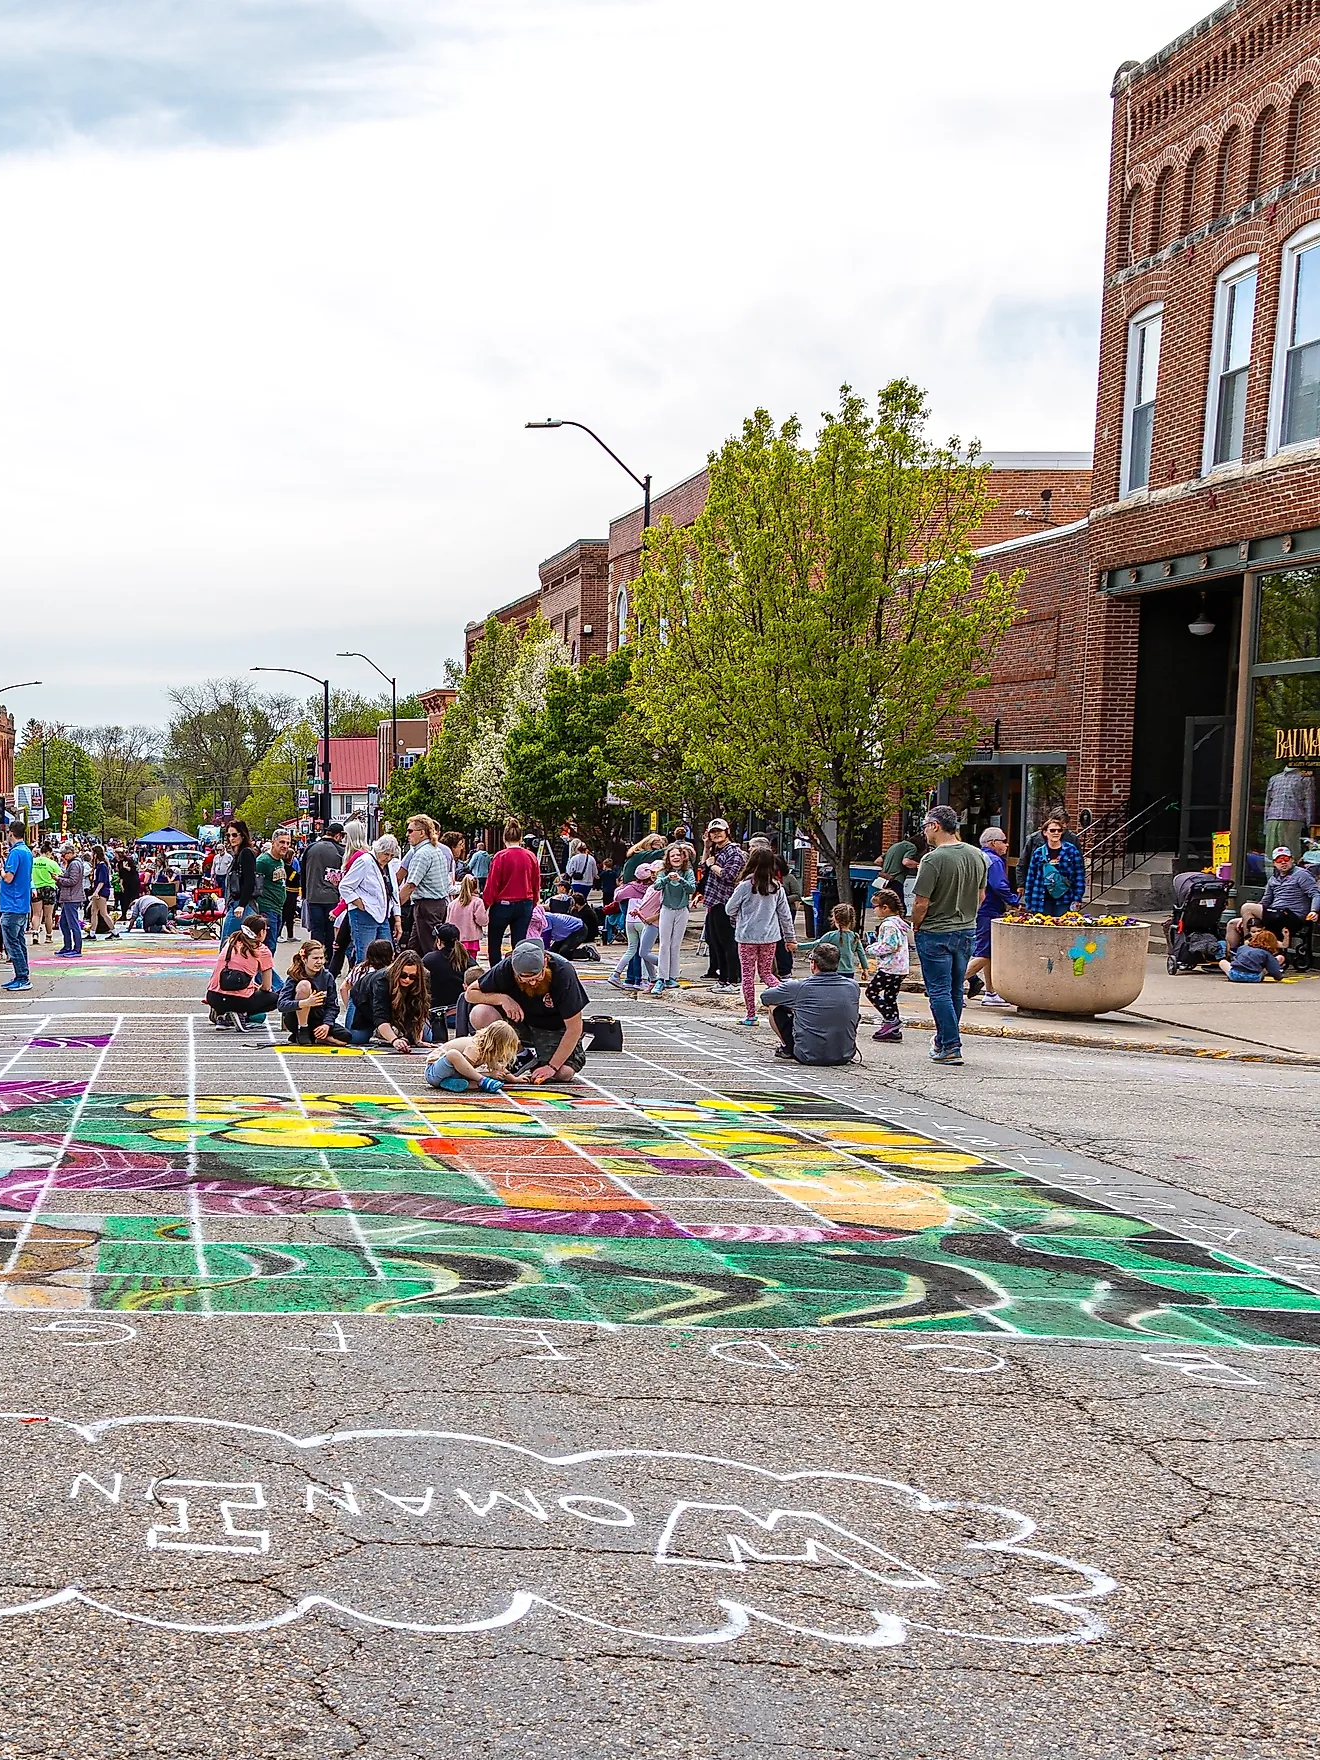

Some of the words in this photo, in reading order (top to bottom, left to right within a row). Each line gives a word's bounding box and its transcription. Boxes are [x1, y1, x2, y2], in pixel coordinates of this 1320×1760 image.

[1104, 1190, 1176, 1209] 5
[1179, 1218, 1245, 1242] 4
[29, 1319, 139, 1347] G
[282, 1320, 361, 1354] F
[468, 1327, 583, 1362] E
[709, 1339, 799, 1371] D
[903, 1342, 1007, 1374] C
[1139, 1351, 1262, 1386] B
[68, 1471, 272, 1556] IN
[304, 1480, 940, 1589] WOMAN
